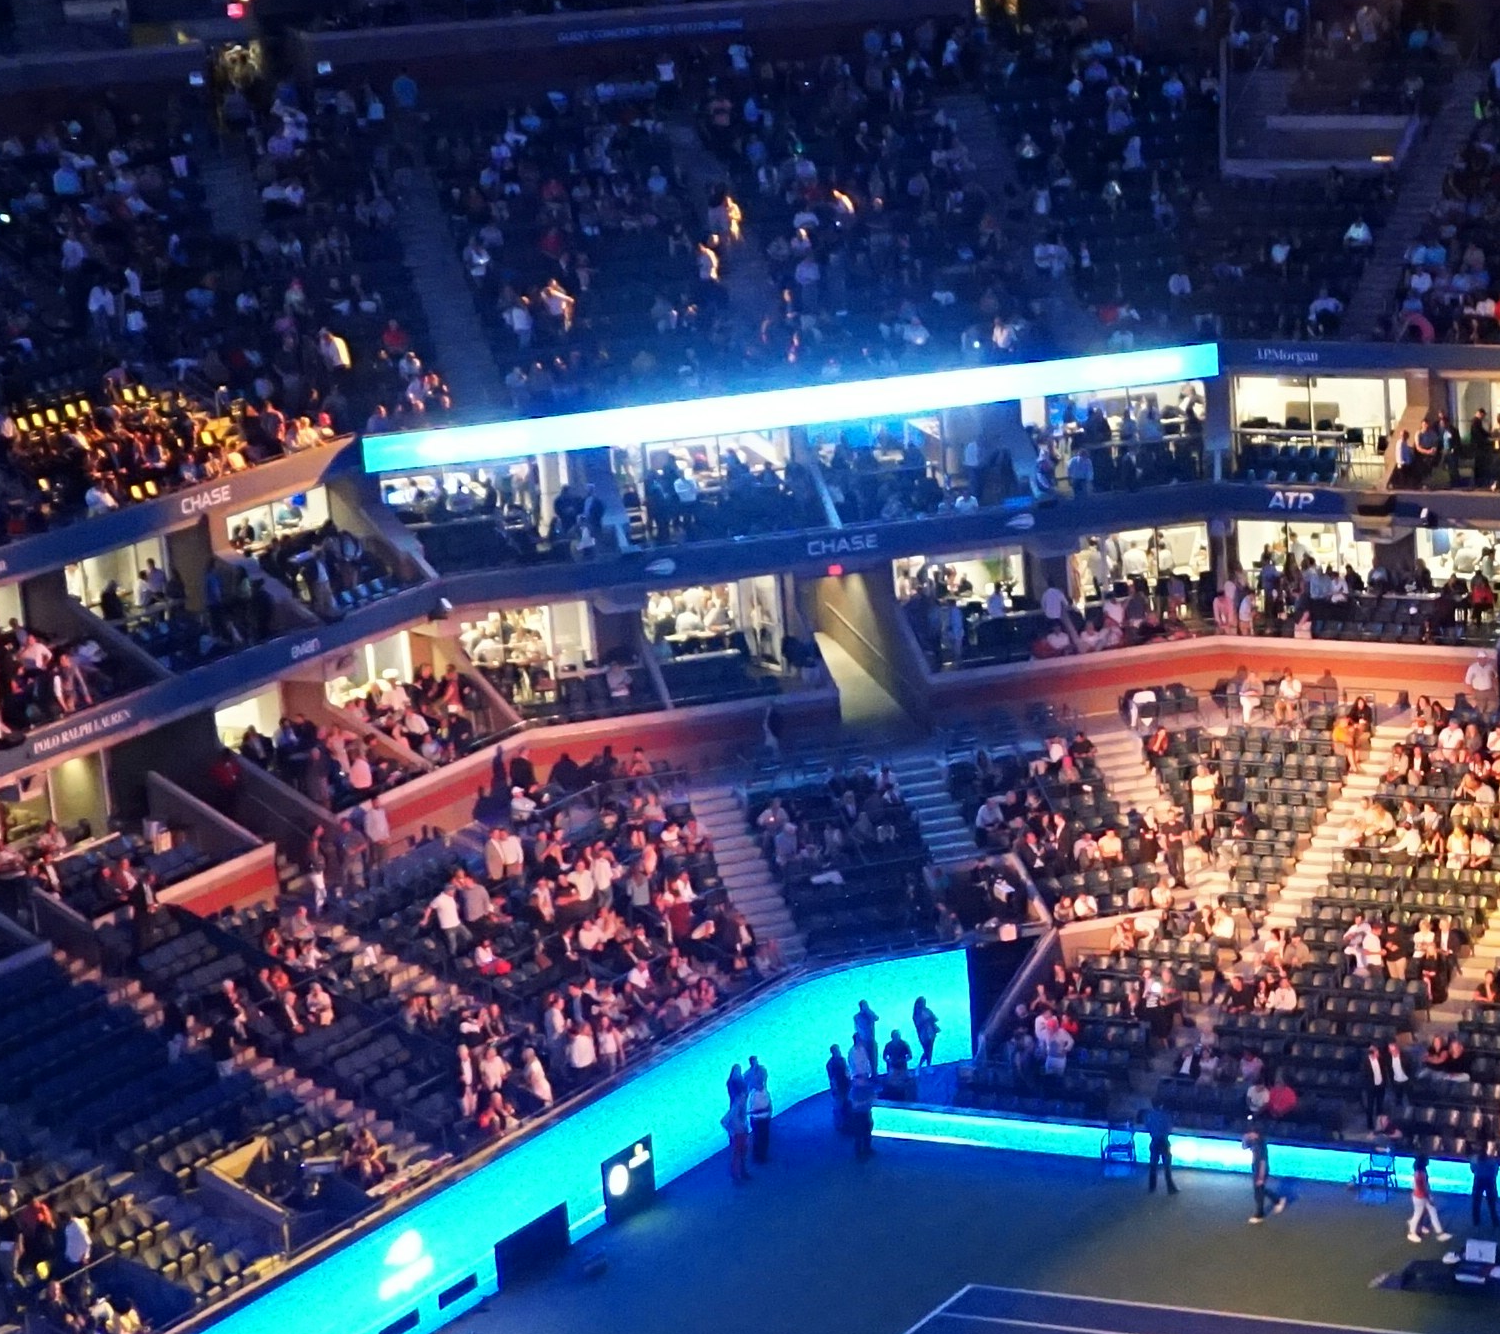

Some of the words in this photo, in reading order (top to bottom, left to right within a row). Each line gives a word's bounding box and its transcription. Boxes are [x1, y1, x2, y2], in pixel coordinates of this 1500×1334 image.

[181, 485, 231, 514] CHASE
[1267, 491, 1315, 510] ATP
[807, 533, 879, 557] CHASE
